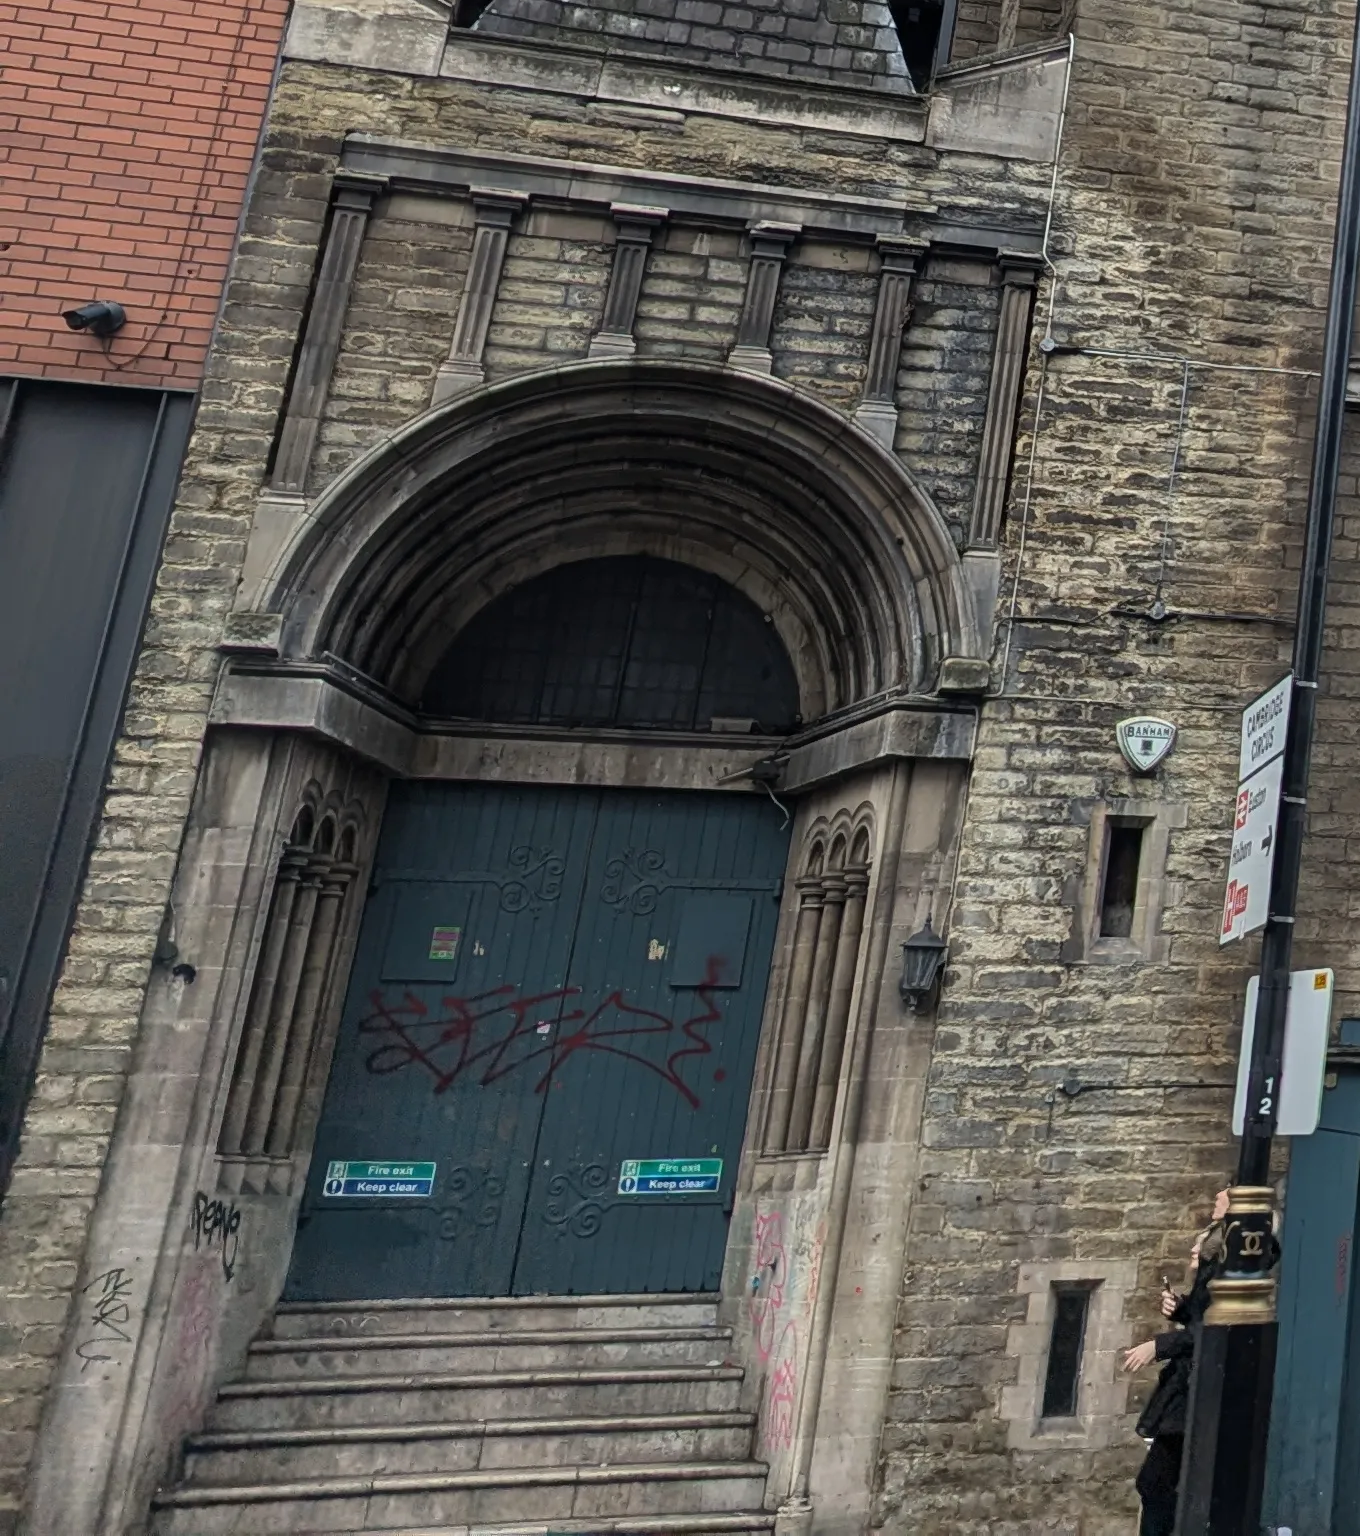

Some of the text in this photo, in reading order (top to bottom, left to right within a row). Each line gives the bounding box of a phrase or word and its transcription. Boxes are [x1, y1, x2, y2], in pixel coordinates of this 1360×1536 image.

[1128, 726, 1170, 737] BANHAM
[1251, 726, 1275, 762] CIRCUS
[367, 1166, 413, 1175] Fire exit
[658, 1162, 700, 1172] Fire exit
[357, 1181, 417, 1193] Keep clear
[649, 1178, 705, 1190] Keep clear
